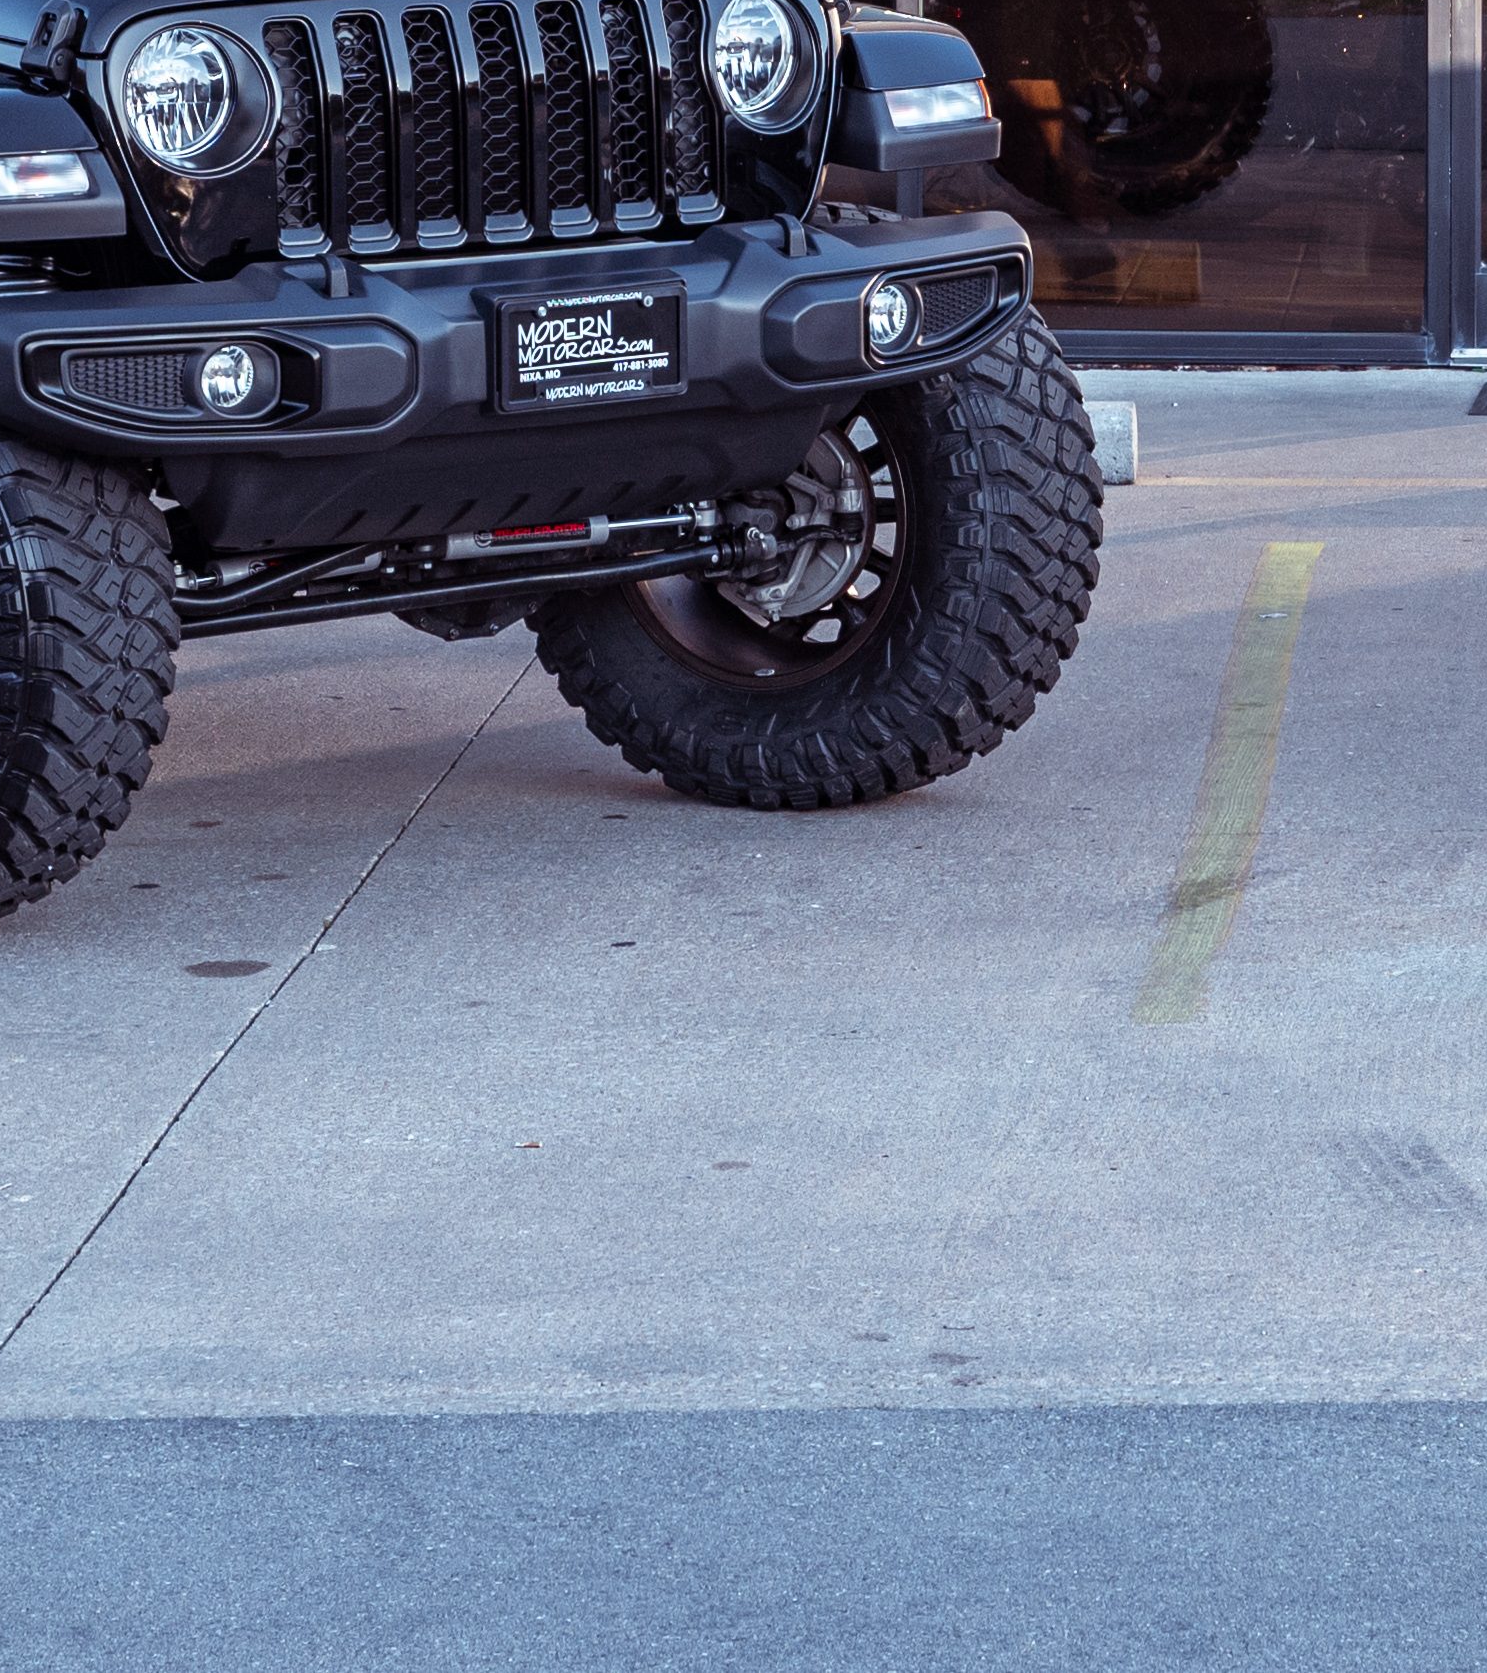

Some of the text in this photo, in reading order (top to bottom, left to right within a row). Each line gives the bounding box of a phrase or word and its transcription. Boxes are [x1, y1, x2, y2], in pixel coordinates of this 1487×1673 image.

[517, 308, 613, 350] MODERN
[545, 368, 562, 381] MO
[544, 378, 645, 402] MODERN MOTORCARS
